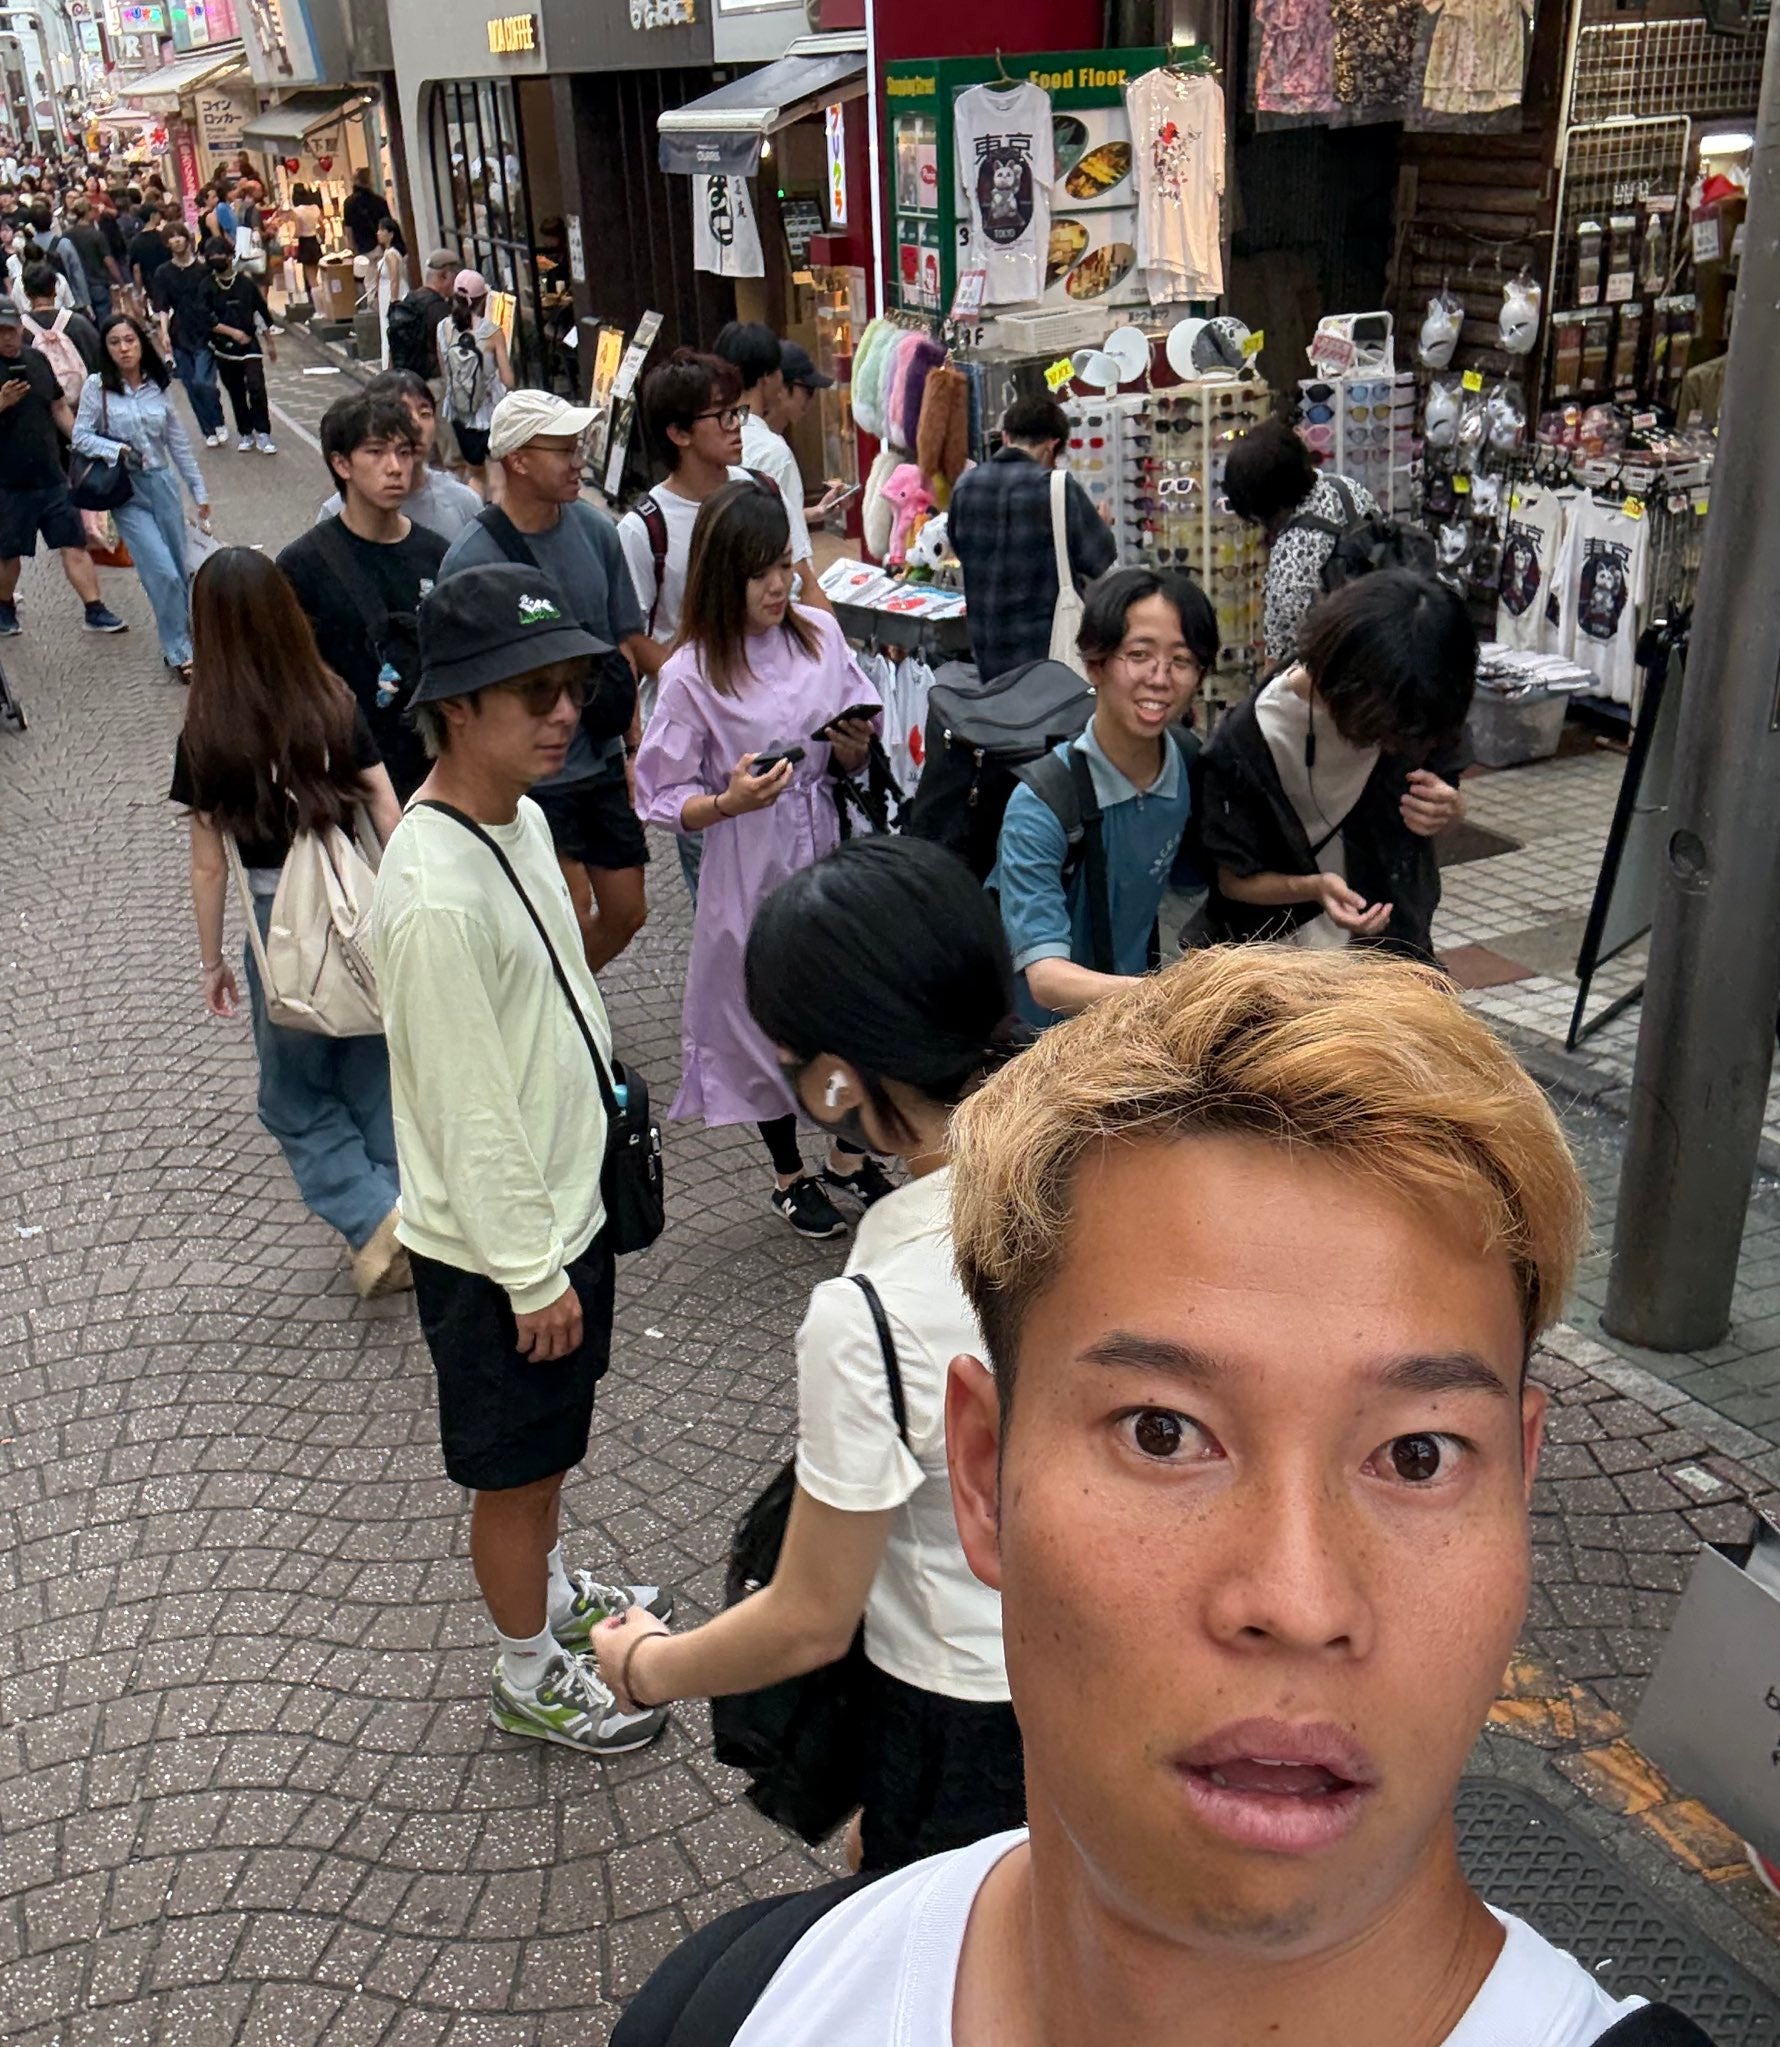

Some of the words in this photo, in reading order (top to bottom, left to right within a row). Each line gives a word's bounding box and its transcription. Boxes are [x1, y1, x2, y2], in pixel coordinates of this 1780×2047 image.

[1029, 69, 1073, 89] Food
[1079, 67, 1127, 87] Floor
[202, 100, 231, 112] コイン
[204, 113, 242, 124] ロッカー
[973, 132, 1033, 165] 東京
[994, 228, 1016, 238] TOKYO
[1583, 536, 1633, 574] 東京
